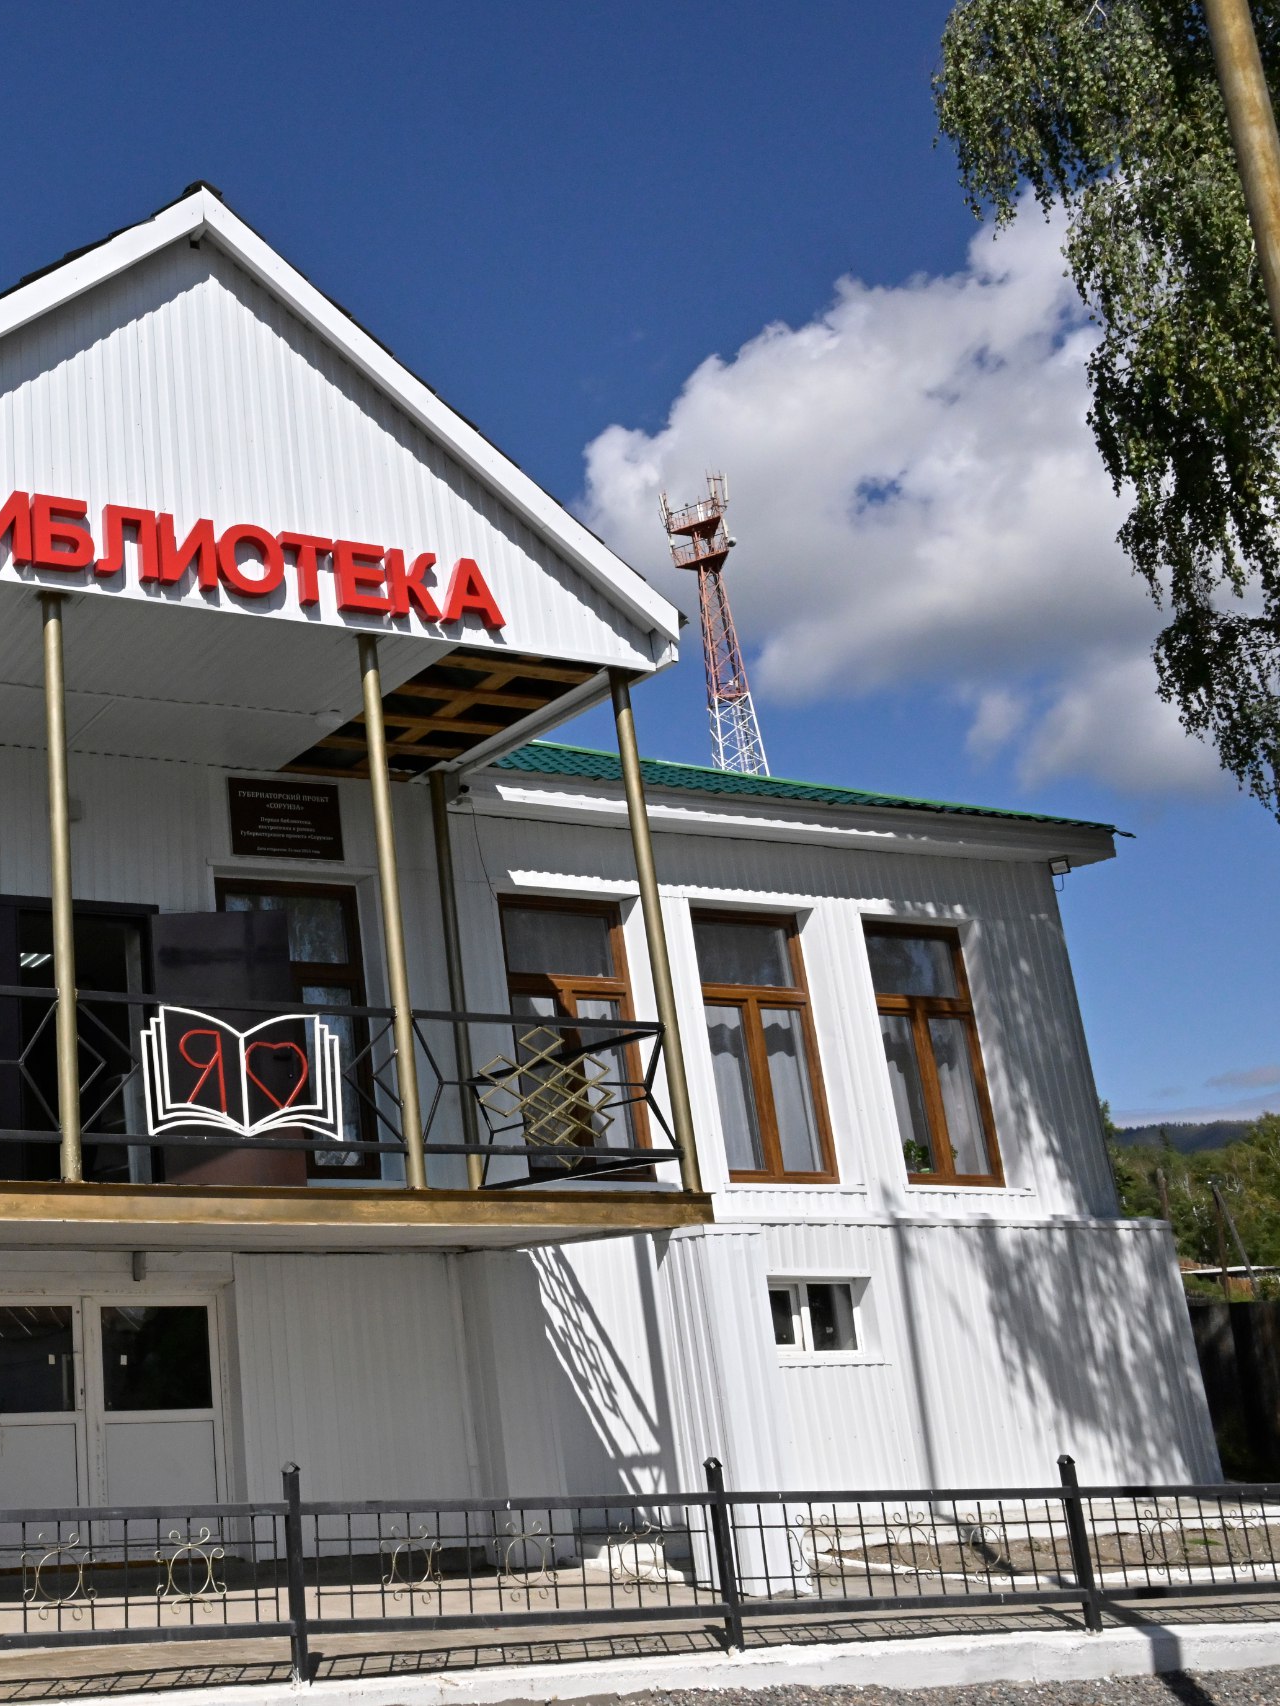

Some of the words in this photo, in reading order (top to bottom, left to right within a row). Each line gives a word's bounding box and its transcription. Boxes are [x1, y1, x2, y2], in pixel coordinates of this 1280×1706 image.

[238, 790, 301, 801] ГУБЕРНАТОРСКИЙ
[302, 795, 329, 803] ПРОЕКТ
[179, 1029, 228, 1117] Я
